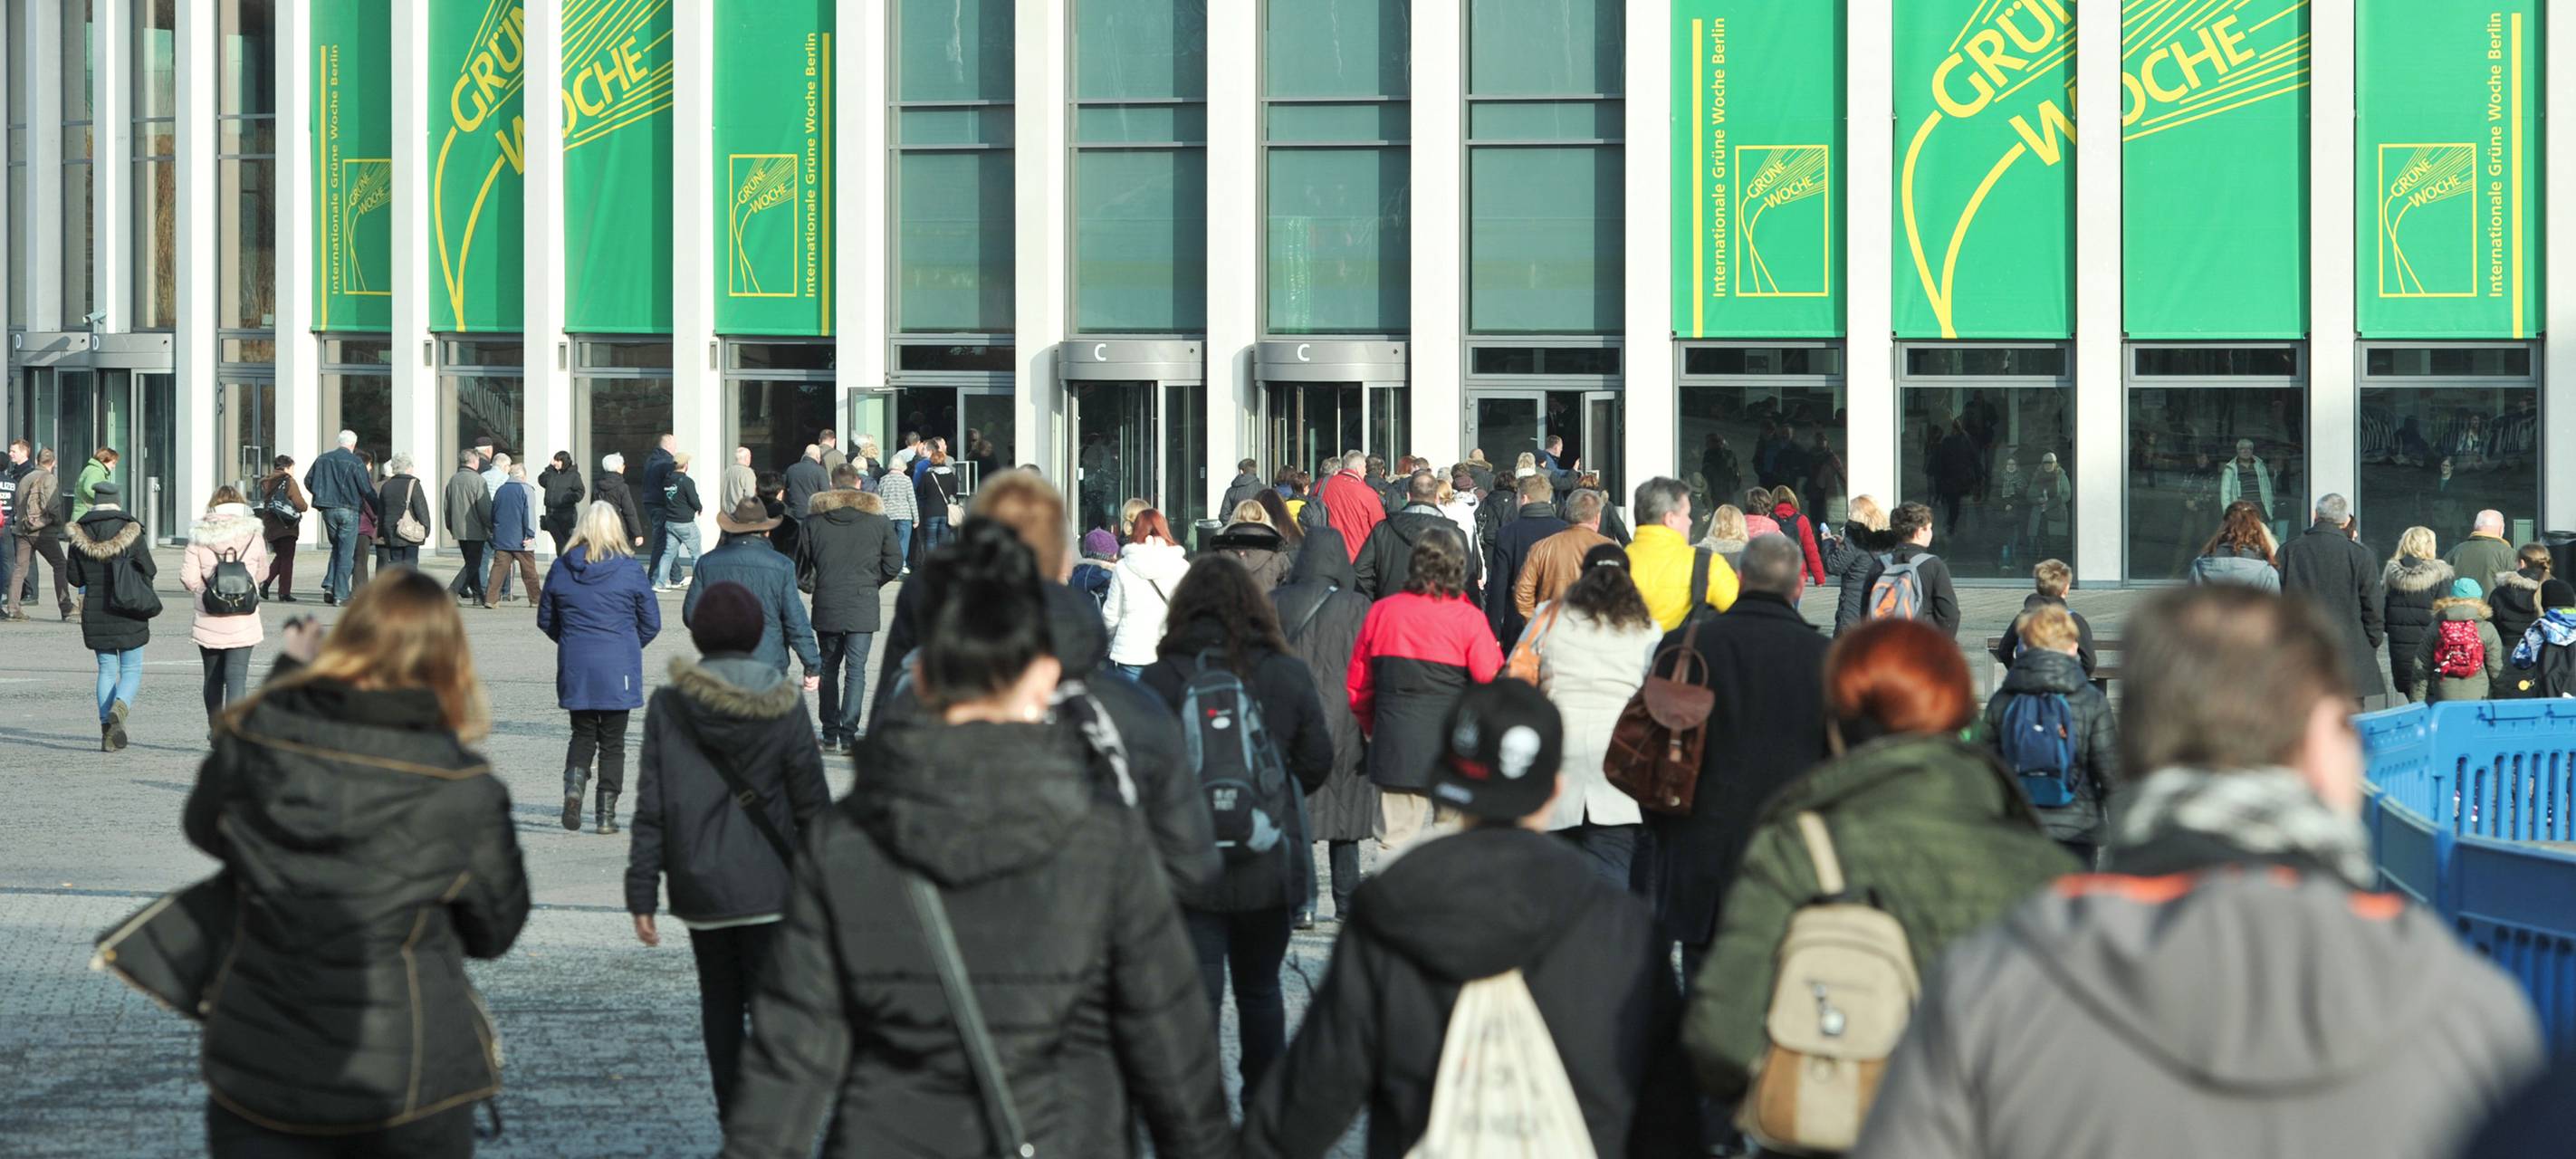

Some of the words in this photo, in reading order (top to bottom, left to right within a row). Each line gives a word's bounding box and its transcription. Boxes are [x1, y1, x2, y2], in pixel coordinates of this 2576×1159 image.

[805, 33, 816, 76] Berlin
[1711, 17, 1726, 64] Berlin
[1931, 0, 2076, 118] GRÜ
[2487, 12, 2503, 60] Berlin
[330, 43, 339, 86] Berlin
[330, 91, 339, 139] Woche
[805, 81, 816, 133] Woche
[1711, 69, 1726, 125] Woche
[2487, 64, 2503, 121] Woche
[330, 145, 339, 188] Grüne
[805, 138, 816, 185] Grüne
[1711, 129, 1726, 178] Grüne
[2487, 126, 2503, 177] Grüne
[750, 182, 787, 214] WOCHE
[1764, 175, 1815, 208] WOCHE
[2408, 173, 2462, 207] WOCHE
[330, 193, 339, 294] Internationale
[805, 189, 816, 298] Internationale
[1711, 183, 1726, 297] Internationale
[2487, 181, 2503, 297] Internationale
[92, 335, 100, 351] D
[1094, 342, 1106, 362] C
[1297, 343, 1310, 362] C
